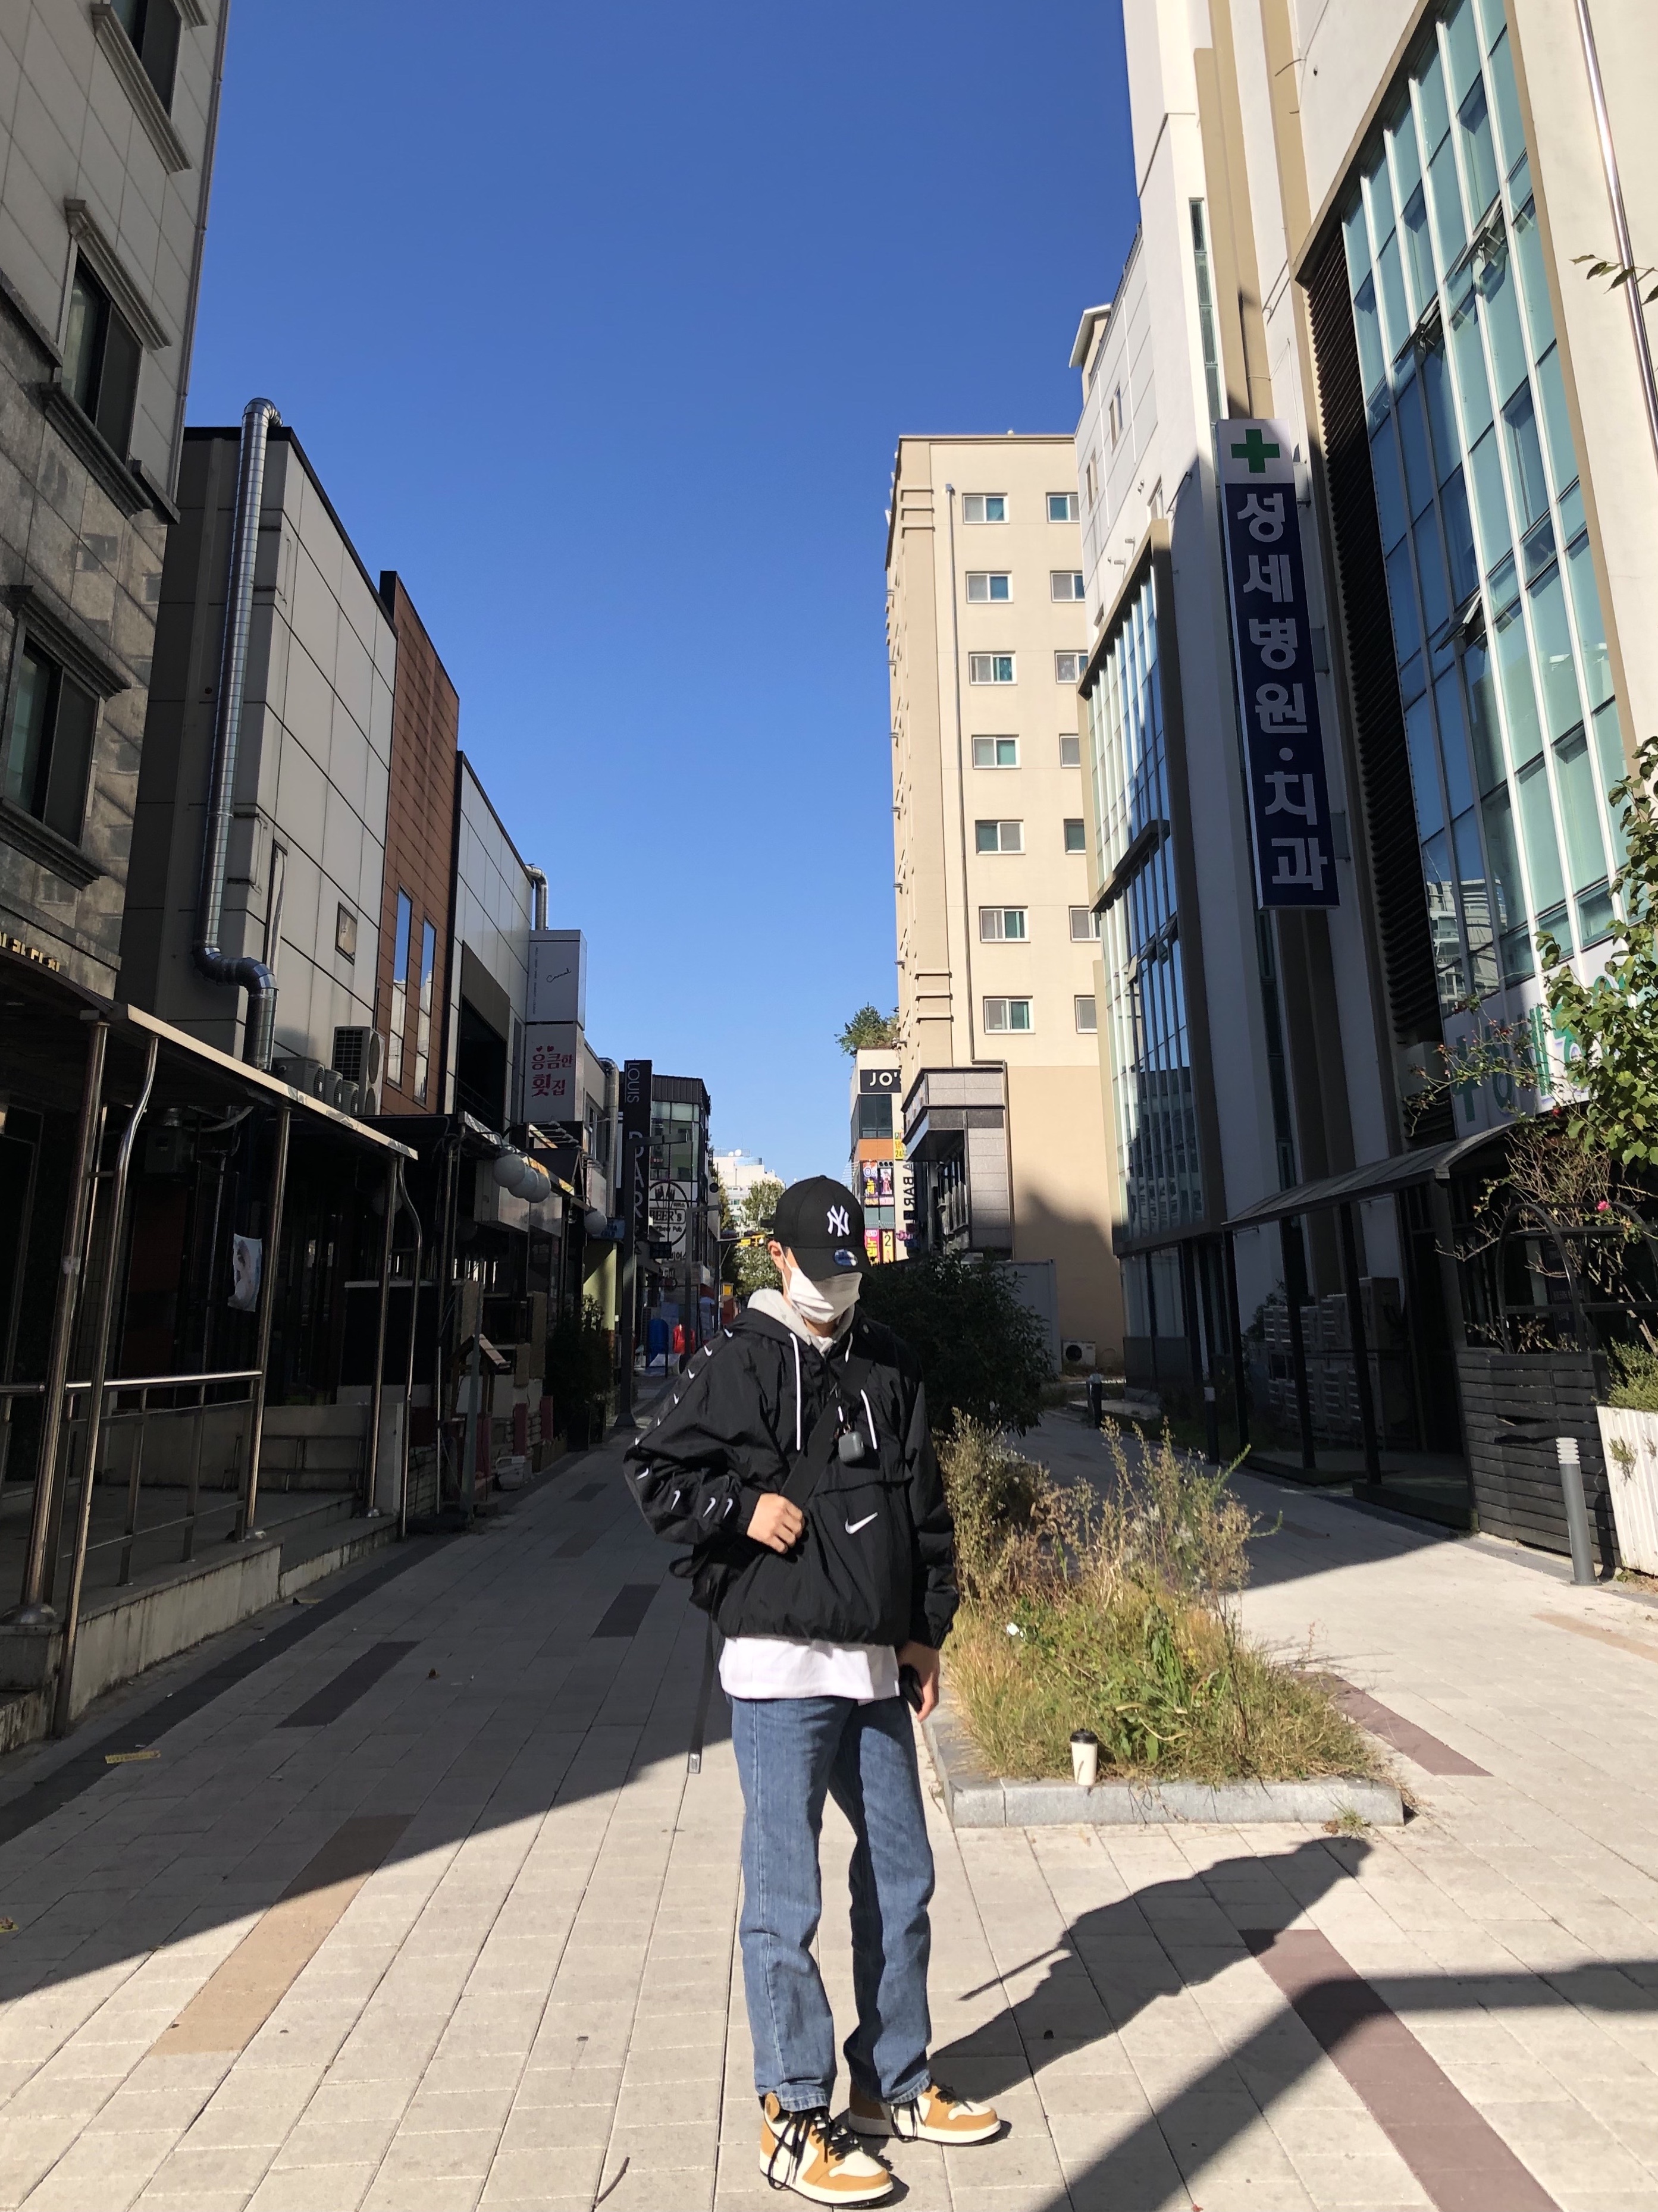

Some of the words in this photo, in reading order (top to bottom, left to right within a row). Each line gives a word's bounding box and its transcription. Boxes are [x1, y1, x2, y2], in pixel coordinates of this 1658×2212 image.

[531, 1053, 573, 1070] 응큼한
[531, 1074, 566, 1097] 횟집
[627, 1063, 640, 1103] LOUIS
[869, 1072, 901, 1087] JO'
[826, 1204, 850, 1237] NY
[884, 1234, 891, 1247] 2
